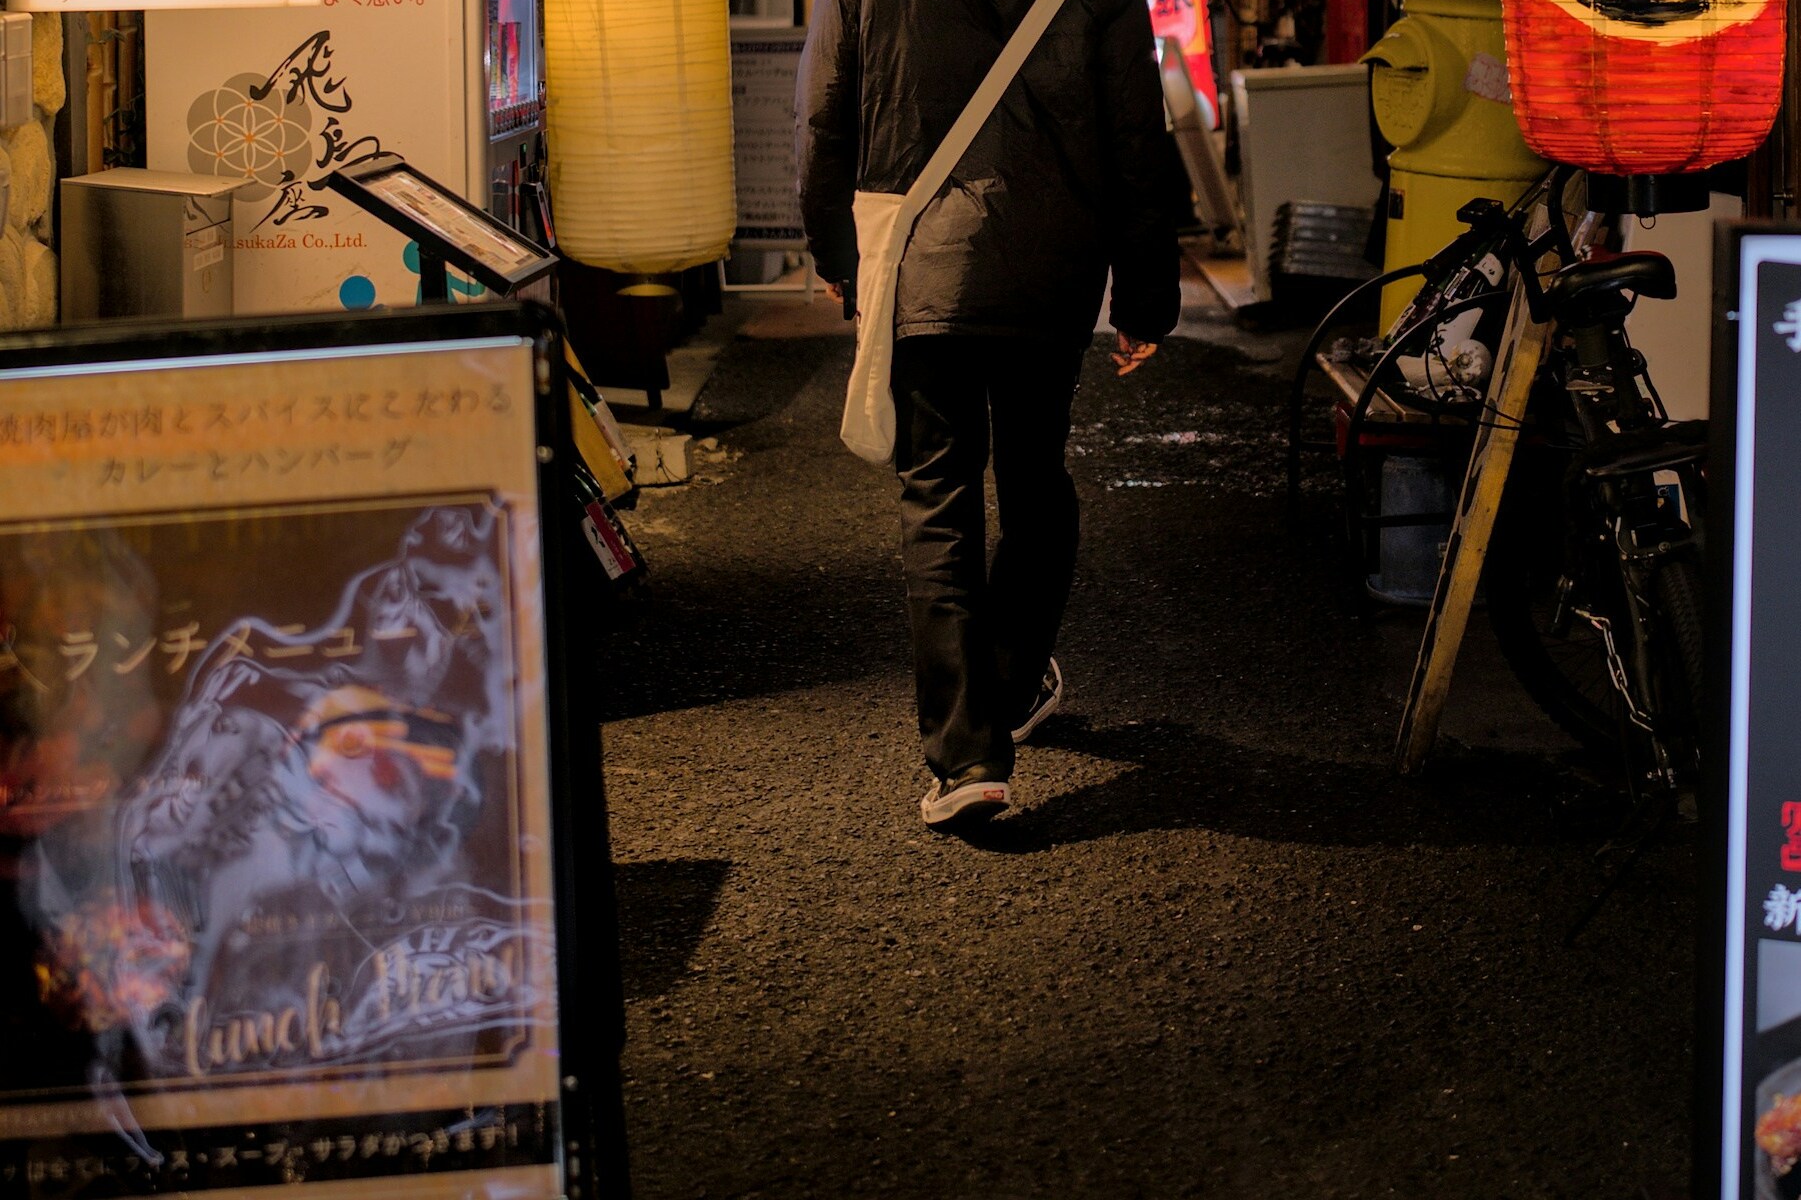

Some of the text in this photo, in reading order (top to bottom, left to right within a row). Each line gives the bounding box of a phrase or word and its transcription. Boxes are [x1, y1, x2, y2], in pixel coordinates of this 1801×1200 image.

[302, 233, 368, 250] Co.,Ltd.
[99, 434, 412, 487] カレーとハンバーグ
[60, 619, 418, 681] ランチメニュー
